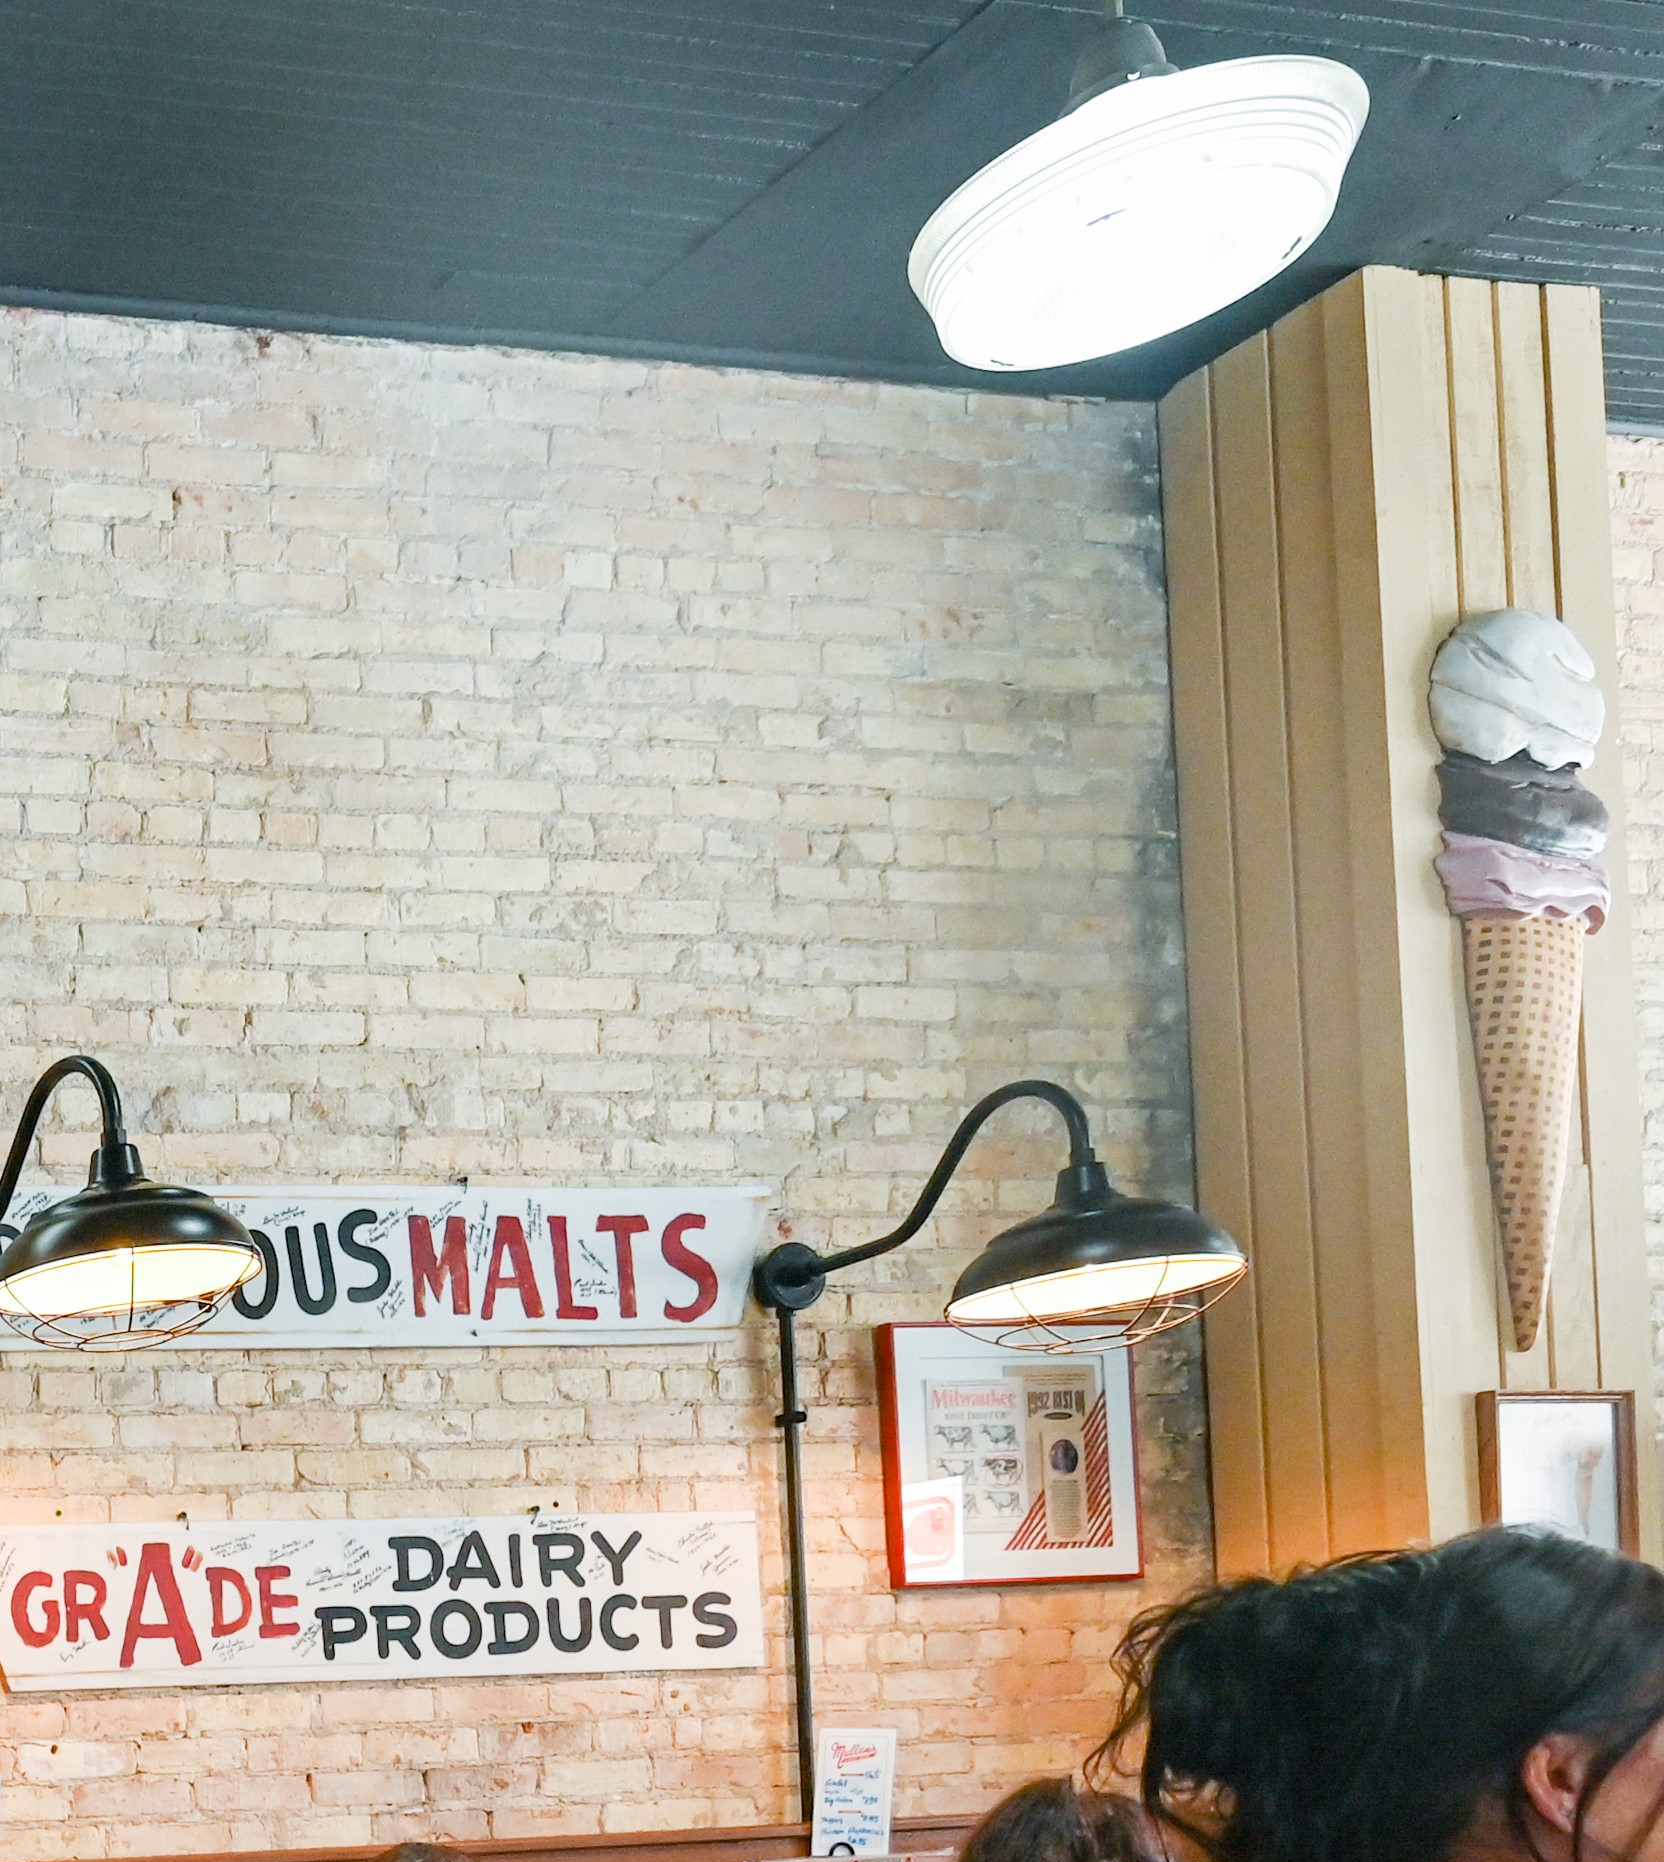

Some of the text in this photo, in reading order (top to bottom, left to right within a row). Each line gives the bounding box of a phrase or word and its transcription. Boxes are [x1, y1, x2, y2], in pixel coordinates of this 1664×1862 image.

[408, 1213, 719, 1322] MALTS
[932, 1388, 1017, 1410] Milwaukee
[389, 1530, 643, 1591] DAIRY
[314, 1592, 738, 1660] PRODUCTS
